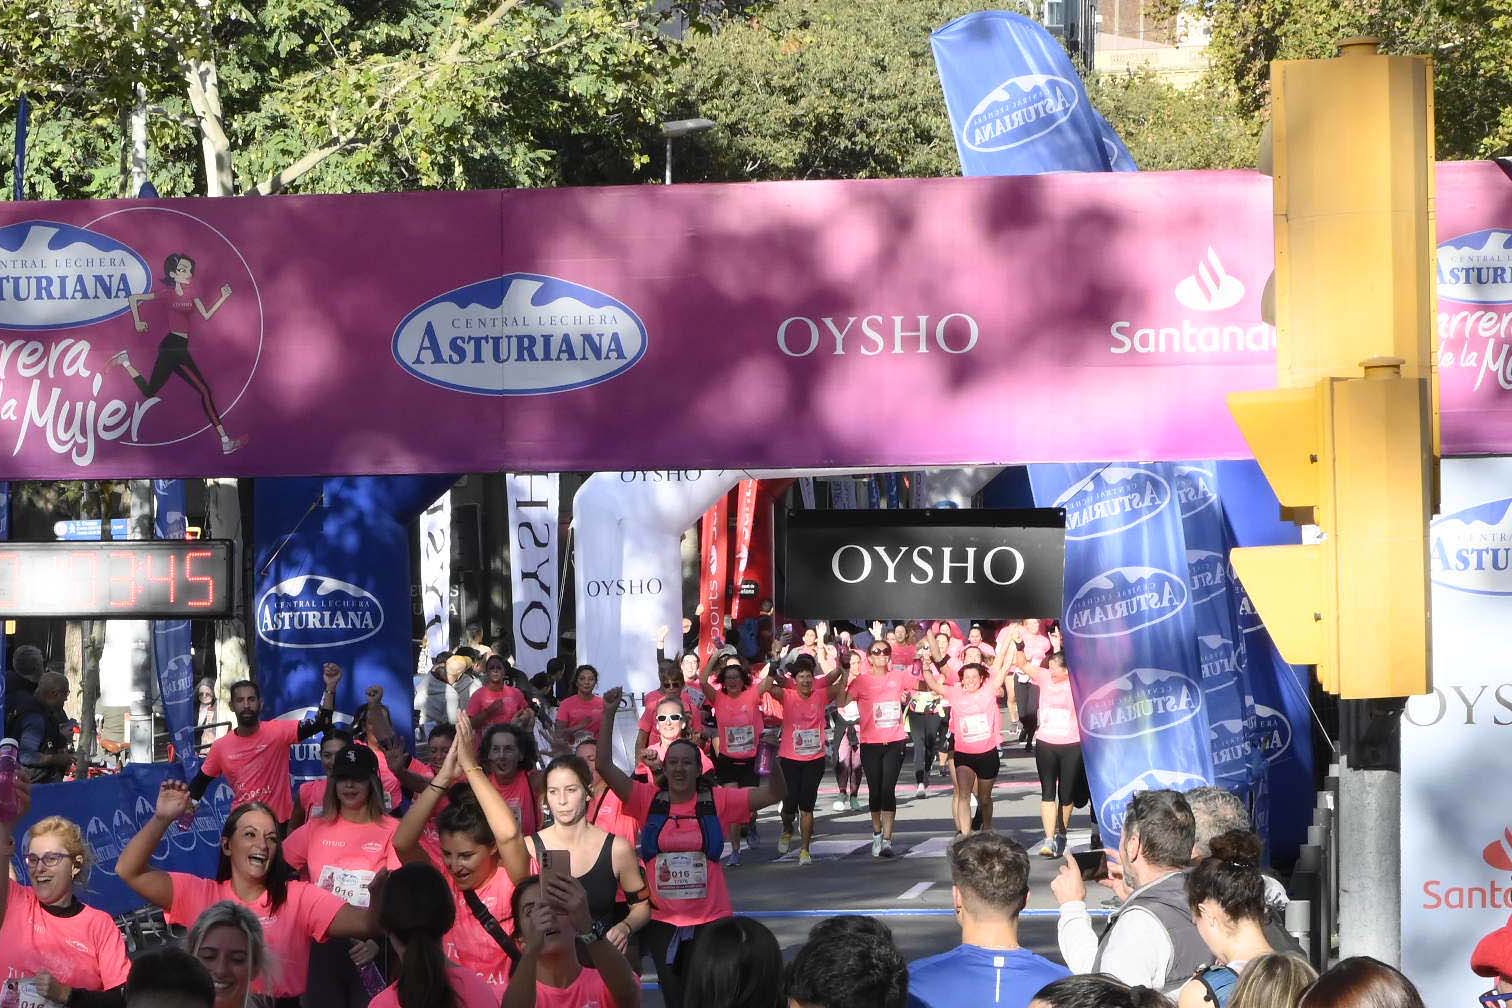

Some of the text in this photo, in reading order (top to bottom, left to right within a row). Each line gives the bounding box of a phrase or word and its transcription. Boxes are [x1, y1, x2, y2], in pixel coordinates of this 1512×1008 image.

[55, 256, 127, 269] LECHERA
[451, 313, 619, 330] CENTRAL LECHERA
[776, 312, 979, 358] OYSHO
[412, 320, 627, 366] ASTURIANA
[1110, 320, 1276, 355] Santand
[12, 372, 162, 467] Mujer
[831, 544, 1025, 586] OYSHO
[587, 577, 662, 598] OYSHO
[262, 604, 376, 633] ASTURIANA
[274, 599, 317, 609] CENTRAL
[334, 886, 354, 897] 016
